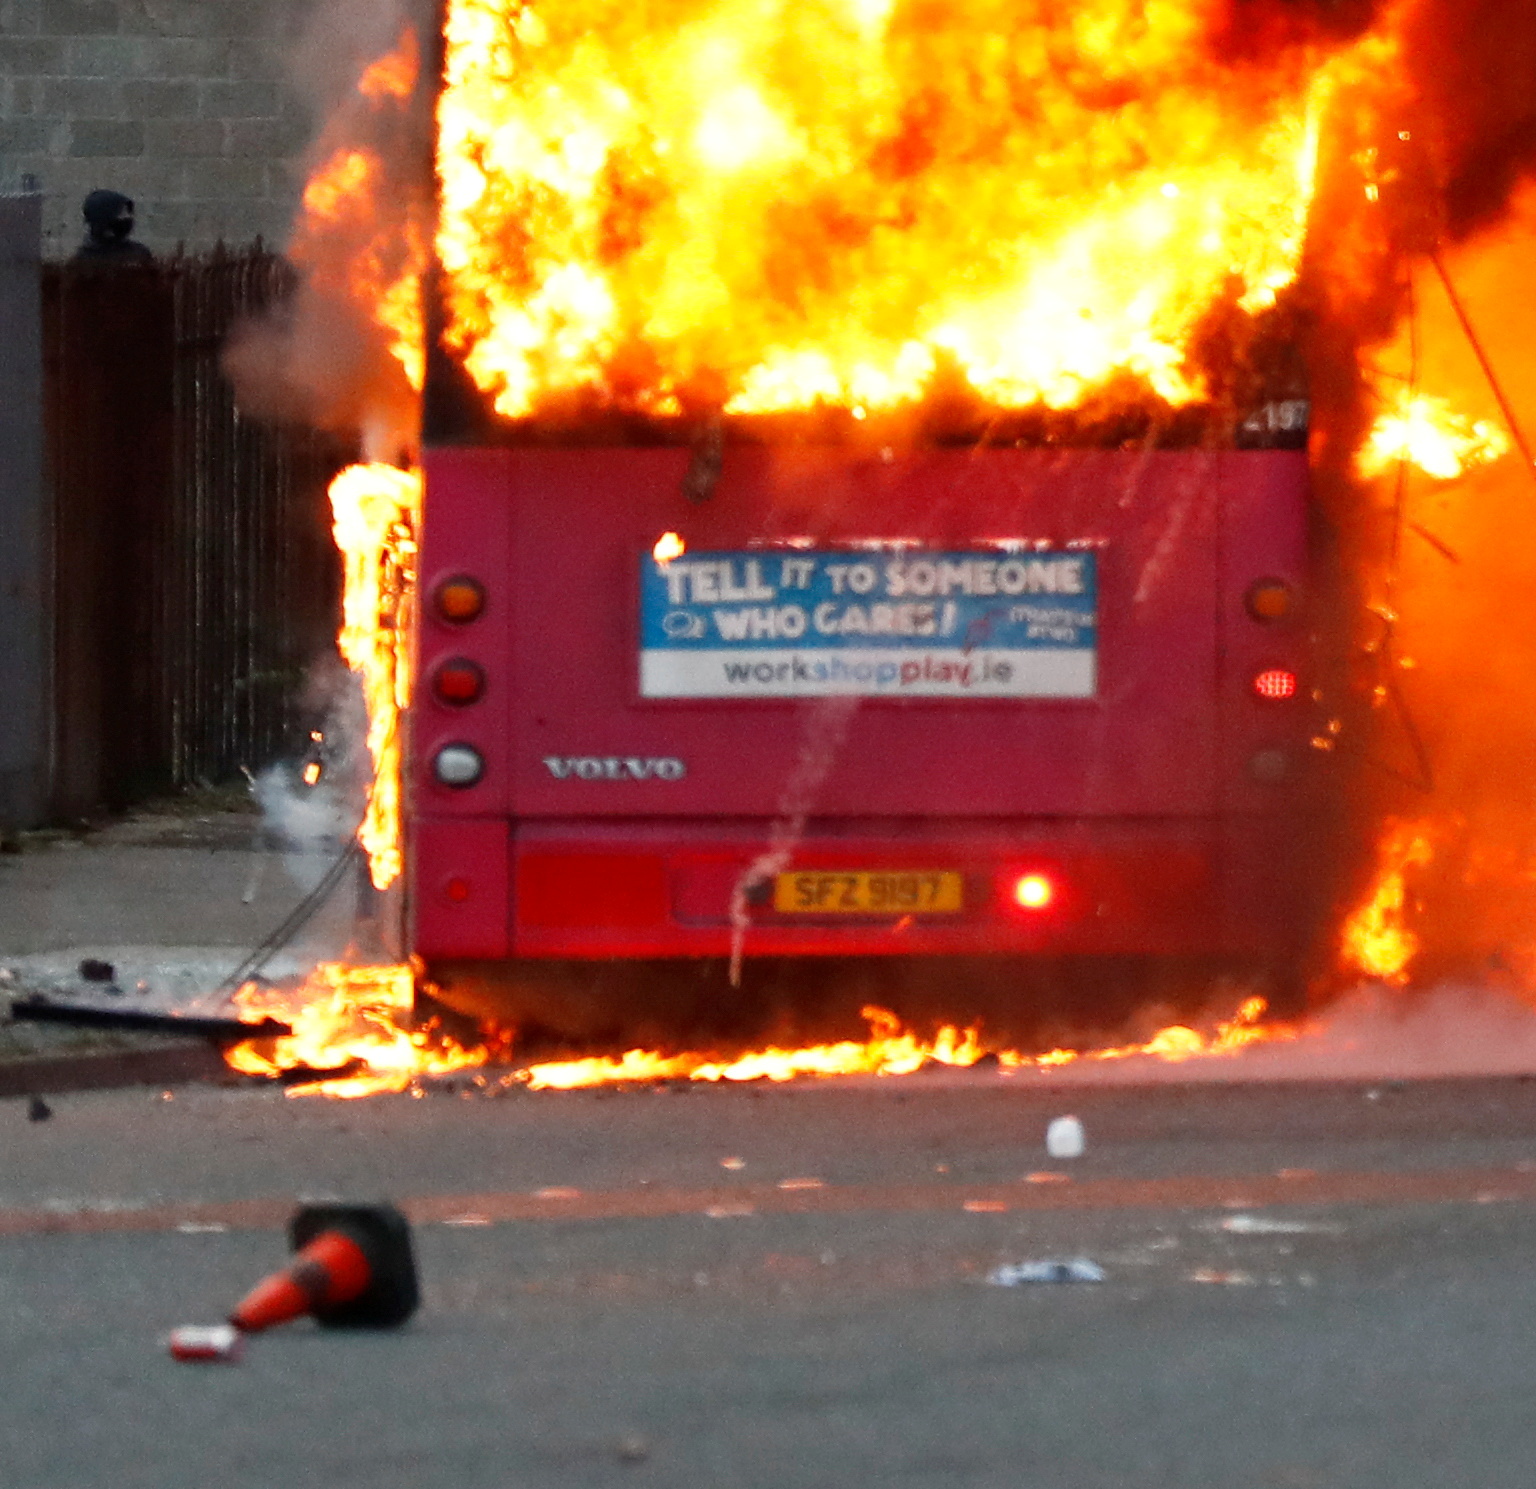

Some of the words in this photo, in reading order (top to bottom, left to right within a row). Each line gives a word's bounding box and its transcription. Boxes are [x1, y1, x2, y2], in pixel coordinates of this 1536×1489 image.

[659, 561, 774, 604] TELL
[781, 559, 814, 589] IT
[825, 563, 876, 595] TO
[885, 559, 1084, 597] SOMEONE
[713, 608, 806, 641] WHO
[814, 601, 957, 638] CARES!
[722, 654, 1015, 688] workshopplay.ie
[542, 755, 687, 782] VOLVO
[794, 876, 860, 906] SFZ
